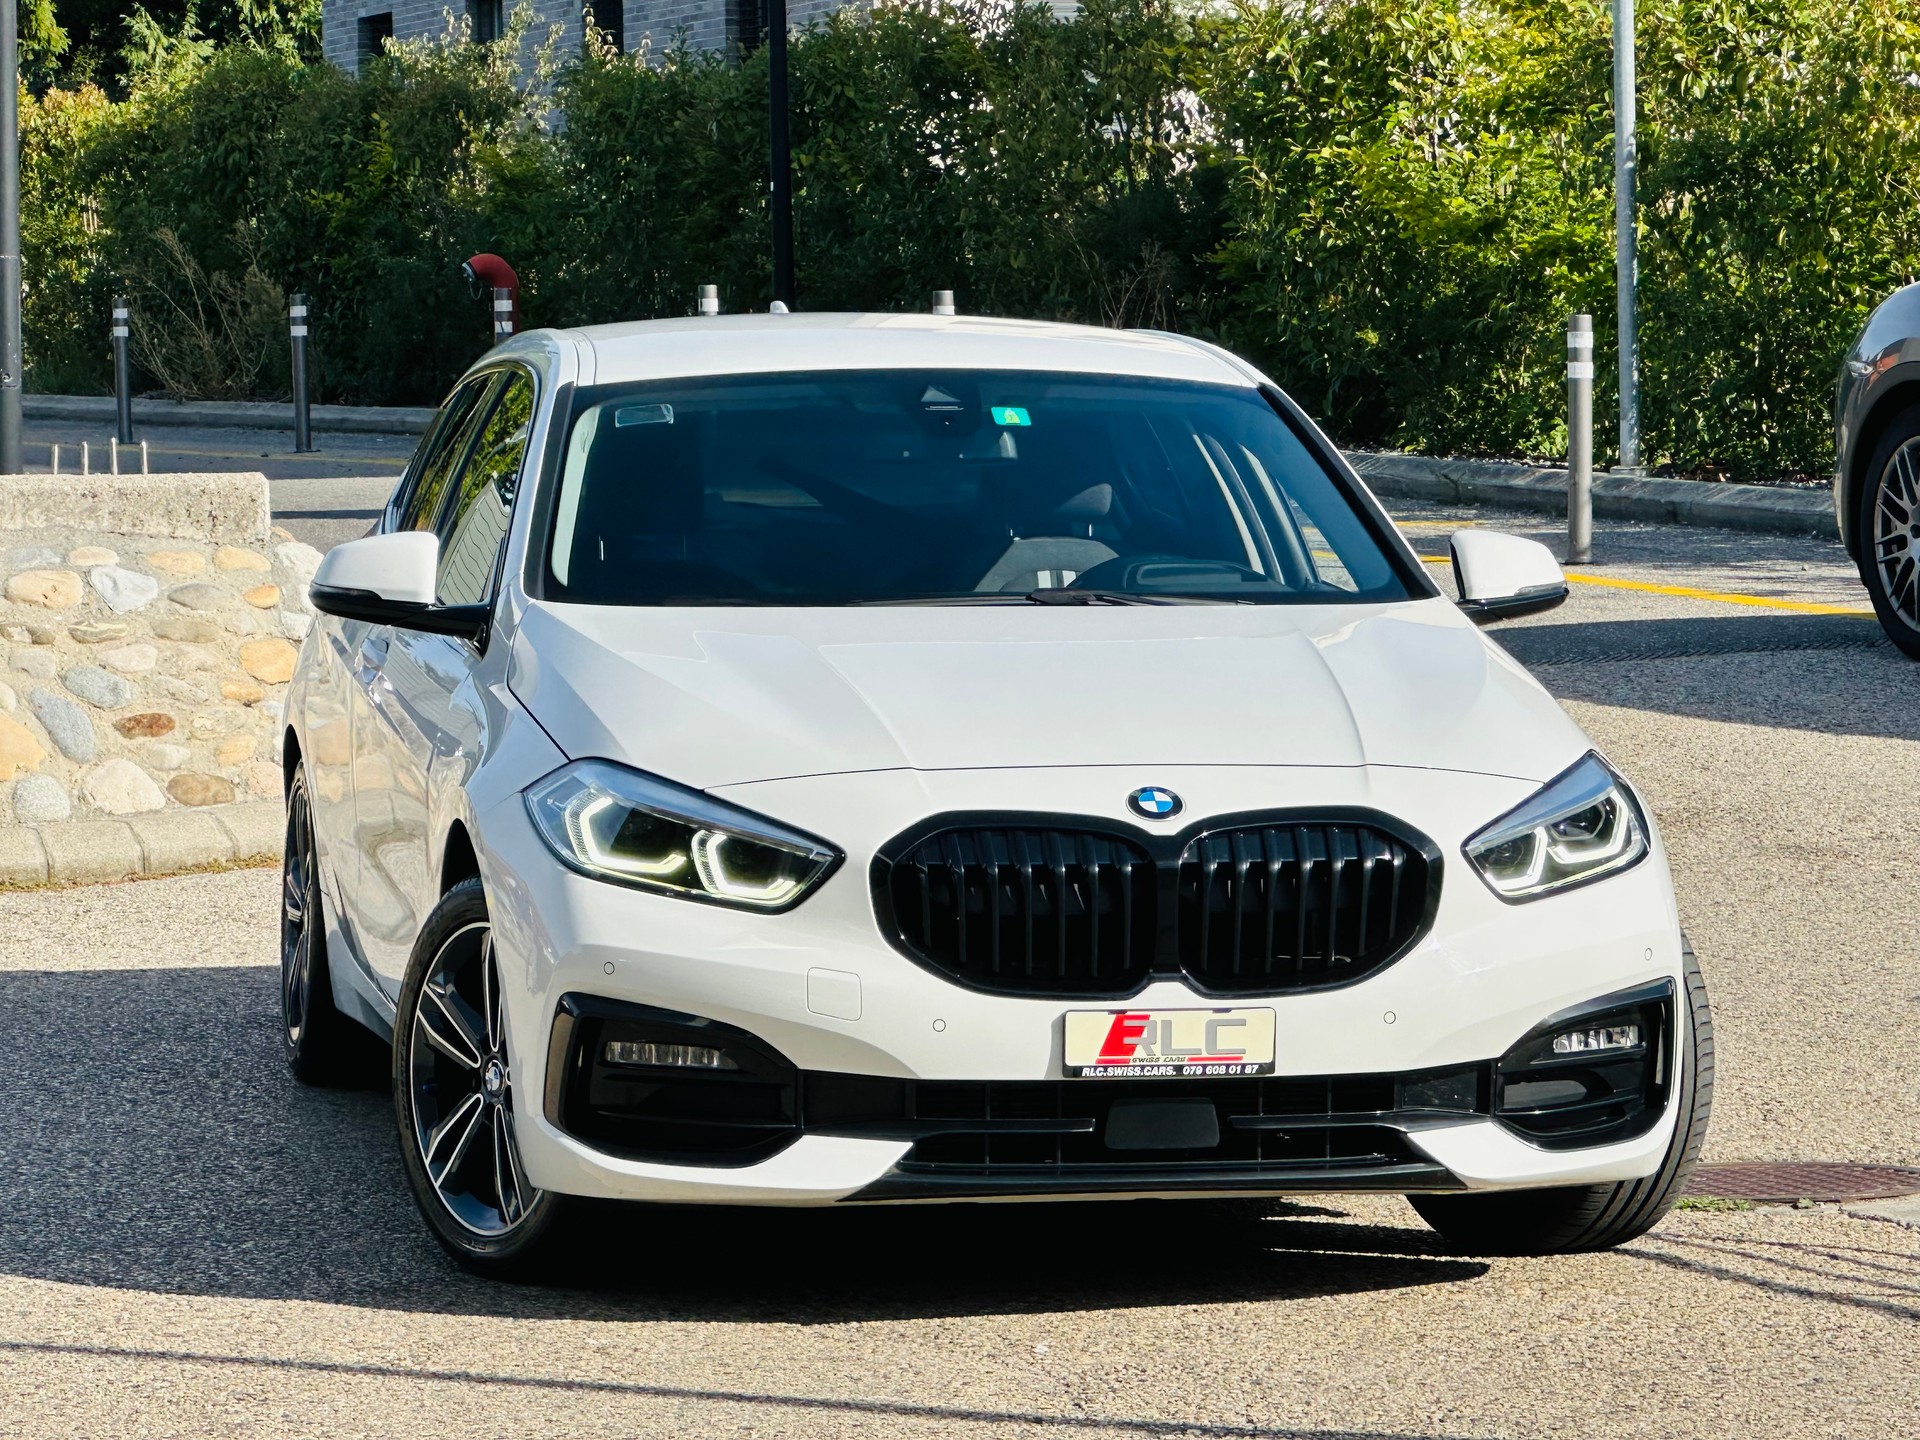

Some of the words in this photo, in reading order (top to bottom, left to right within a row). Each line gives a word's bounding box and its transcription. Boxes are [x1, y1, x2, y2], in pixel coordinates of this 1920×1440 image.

[1182, 1065, 1202, 1076] 079
[1205, 1064, 1225, 1076] 608
[1228, 1064, 1241, 1075] 01
[1244, 1064, 1259, 1074] 87
